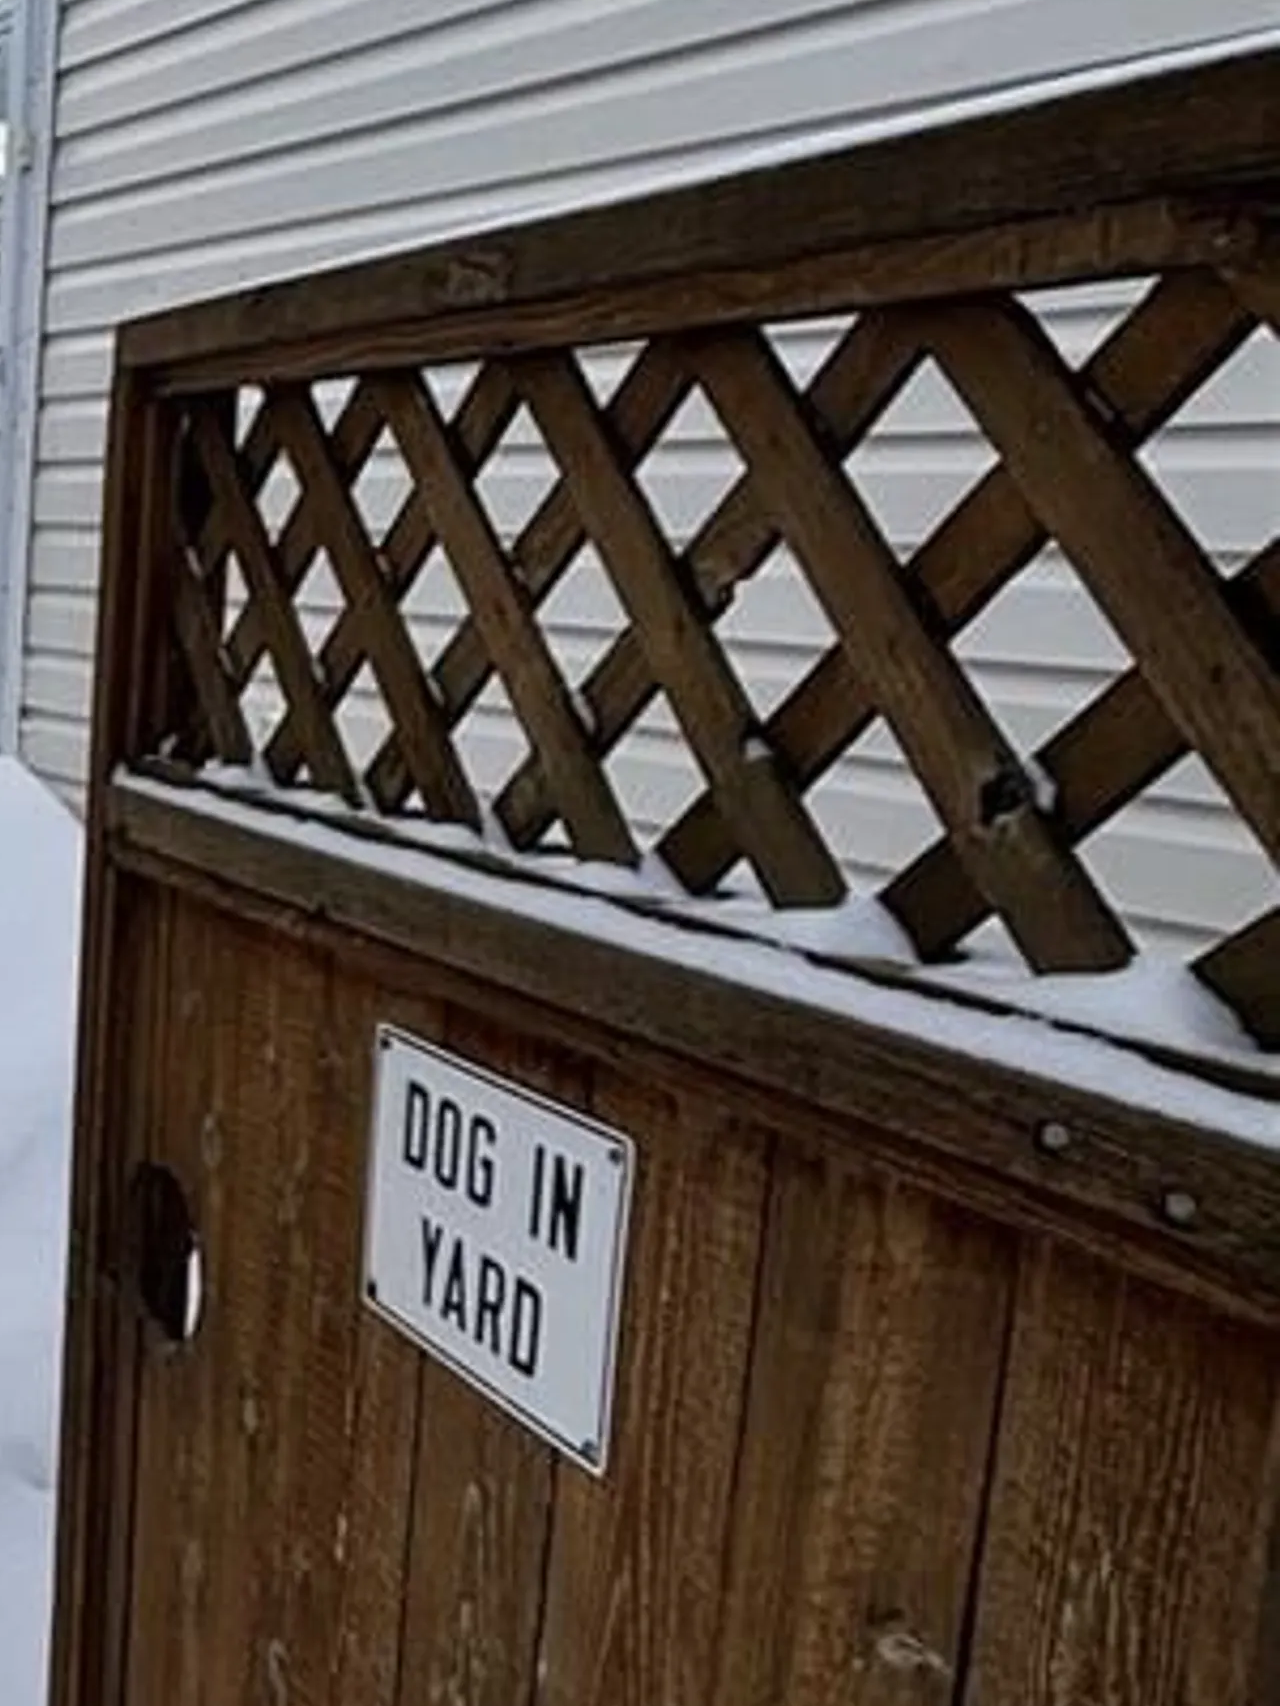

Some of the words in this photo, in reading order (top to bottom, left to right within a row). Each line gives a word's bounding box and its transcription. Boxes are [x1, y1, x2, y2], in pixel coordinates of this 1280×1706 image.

[404, 1079, 497, 1210] DOG
[529, 1143, 584, 1263] IN
[420, 1215, 543, 1379] YARD
